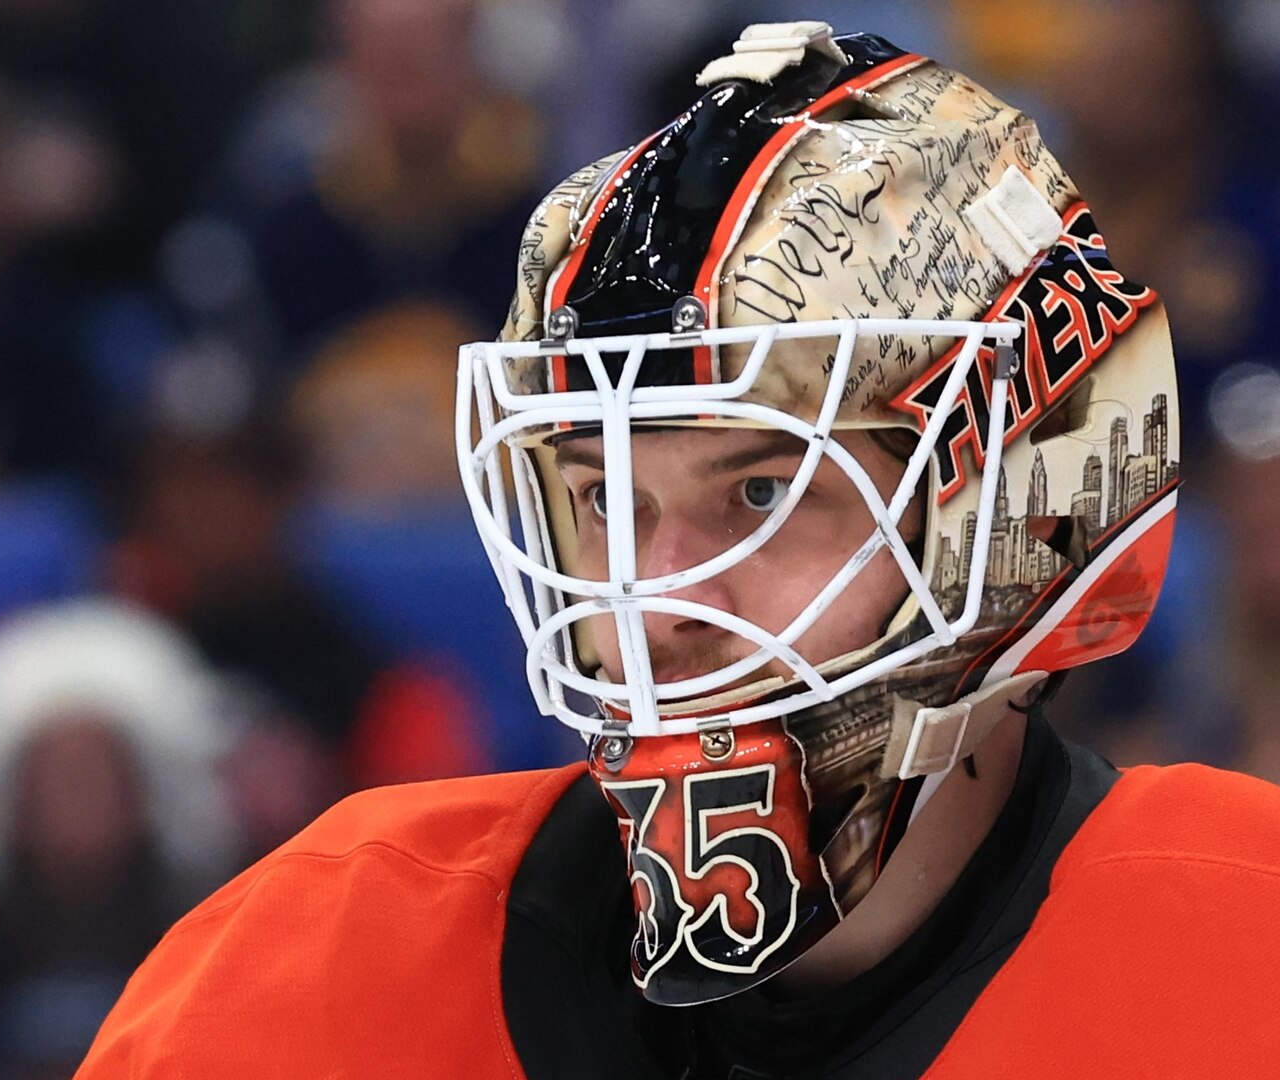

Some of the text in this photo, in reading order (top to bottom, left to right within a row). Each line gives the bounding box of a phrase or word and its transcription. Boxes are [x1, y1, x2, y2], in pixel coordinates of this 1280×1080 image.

[732, 239, 829, 323] We
[896, 203, 1155, 498] FLYERS
[600, 763, 802, 989] 35
